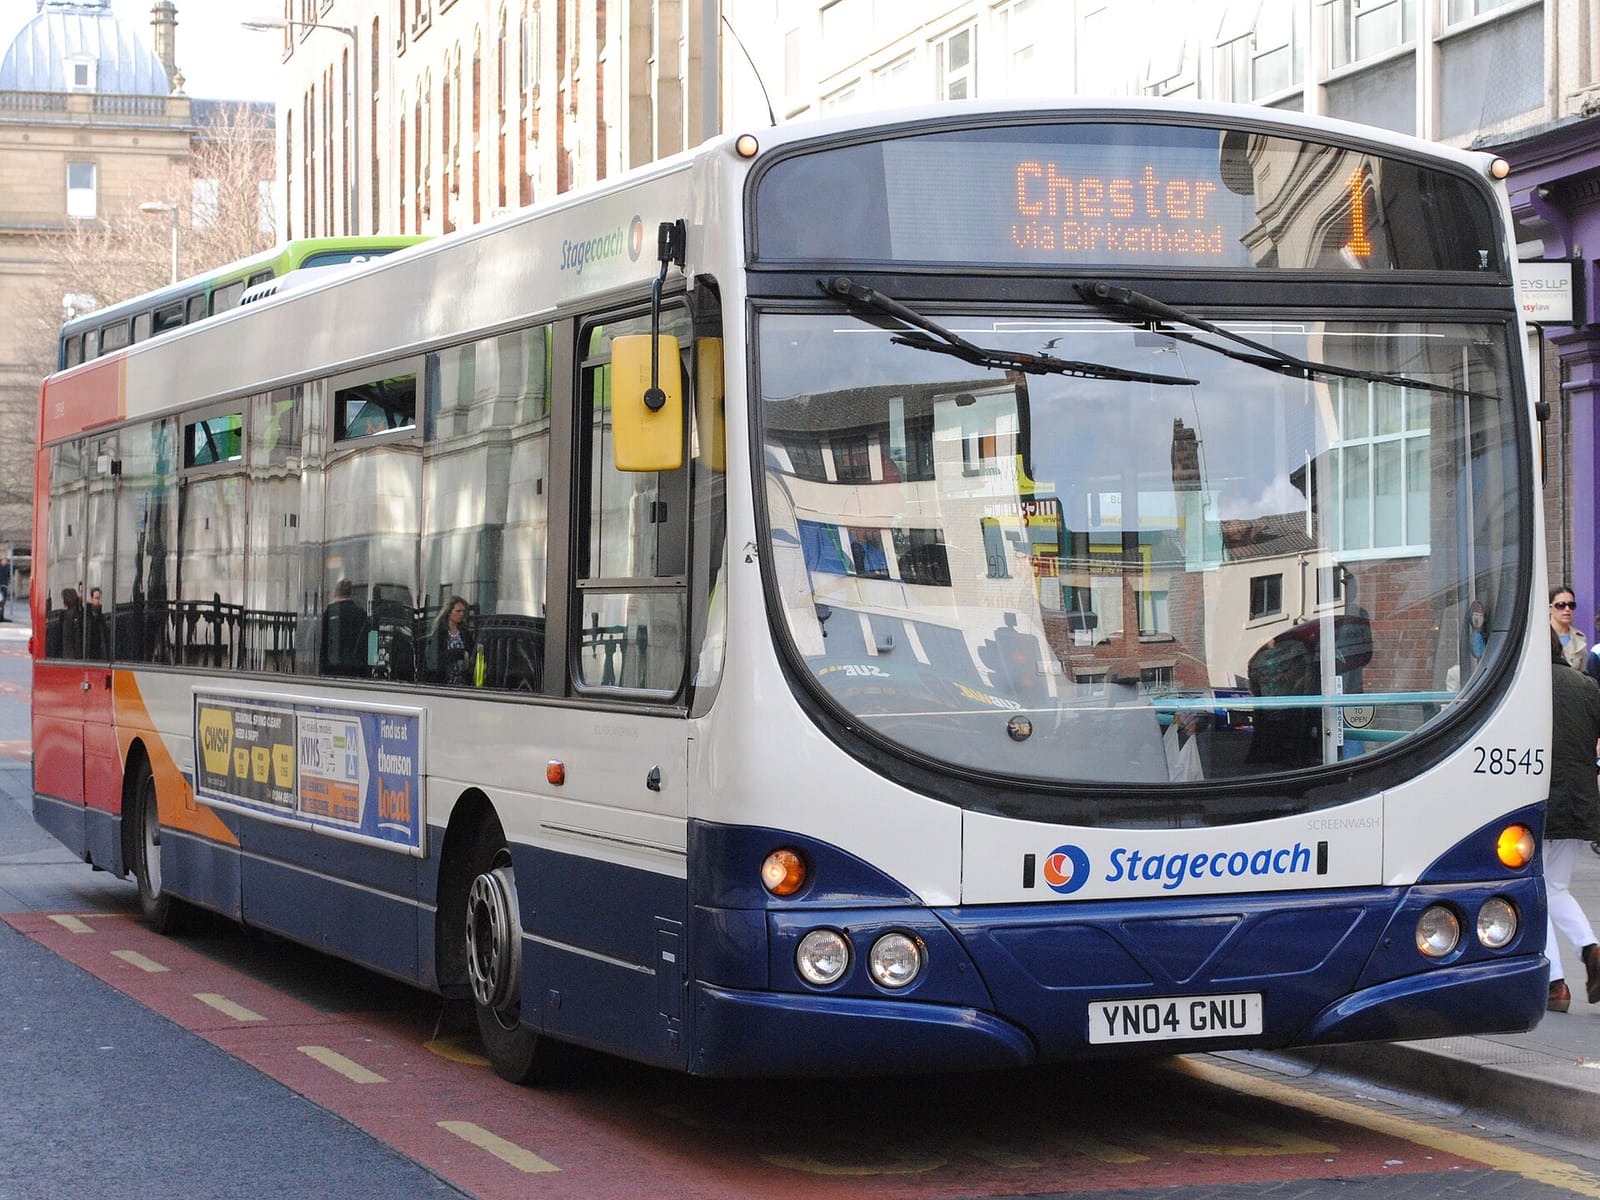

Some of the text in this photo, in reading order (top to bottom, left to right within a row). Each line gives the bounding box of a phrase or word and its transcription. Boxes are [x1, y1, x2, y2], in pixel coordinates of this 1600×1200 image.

[1016, 161, 1216, 218] Chester
[1347, 167, 1371, 257] 1
[560, 226, 624, 275] Stagecoach
[1012, 221, 1223, 252] via Birkenhead
[1545, 279, 1569, 289] LLP
[381, 719, 394, 739] Find
[378, 744, 411, 776] thomson
[1473, 746, 1545, 776] 28545
[378, 776, 411, 823] local
[1307, 816, 1380, 831] SCREENWASH
[1105, 842, 1311, 890] Stagecoach
[1103, 999, 1247, 1036] YN04 GNU
